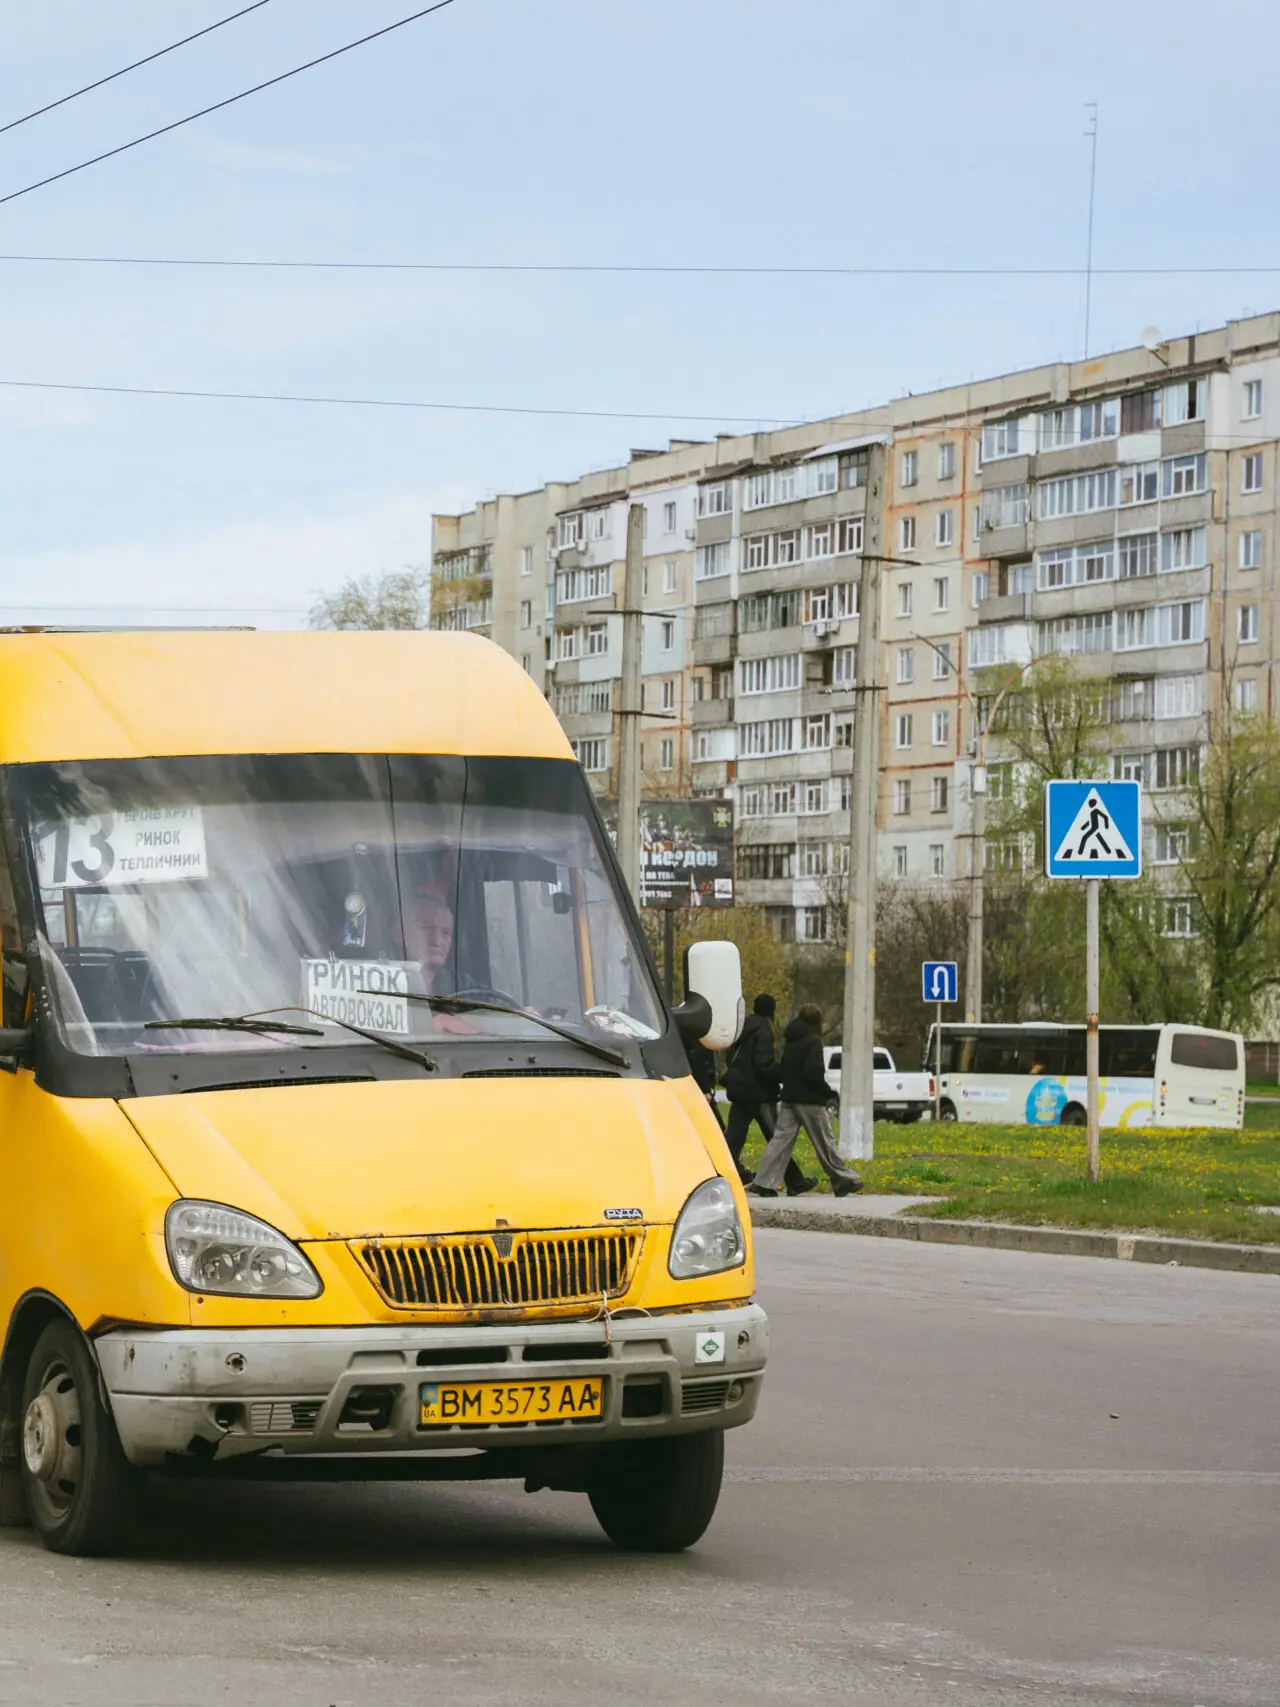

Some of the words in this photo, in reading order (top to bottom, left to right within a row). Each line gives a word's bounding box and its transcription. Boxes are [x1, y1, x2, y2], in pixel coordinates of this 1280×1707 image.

[37, 812, 116, 885] 13
[134, 830, 182, 847] РИНОК
[313, 963, 401, 993] РИНОК
[312, 993, 405, 1031] АВТОВОКЗАЛ
[606, 1209, 642, 1219] РУТА
[423, 1409, 436, 1419] UA
[440, 1388, 483, 1418] BM
[489, 1386, 552, 1416] 3573
[558, 1383, 596, 1413] AA
